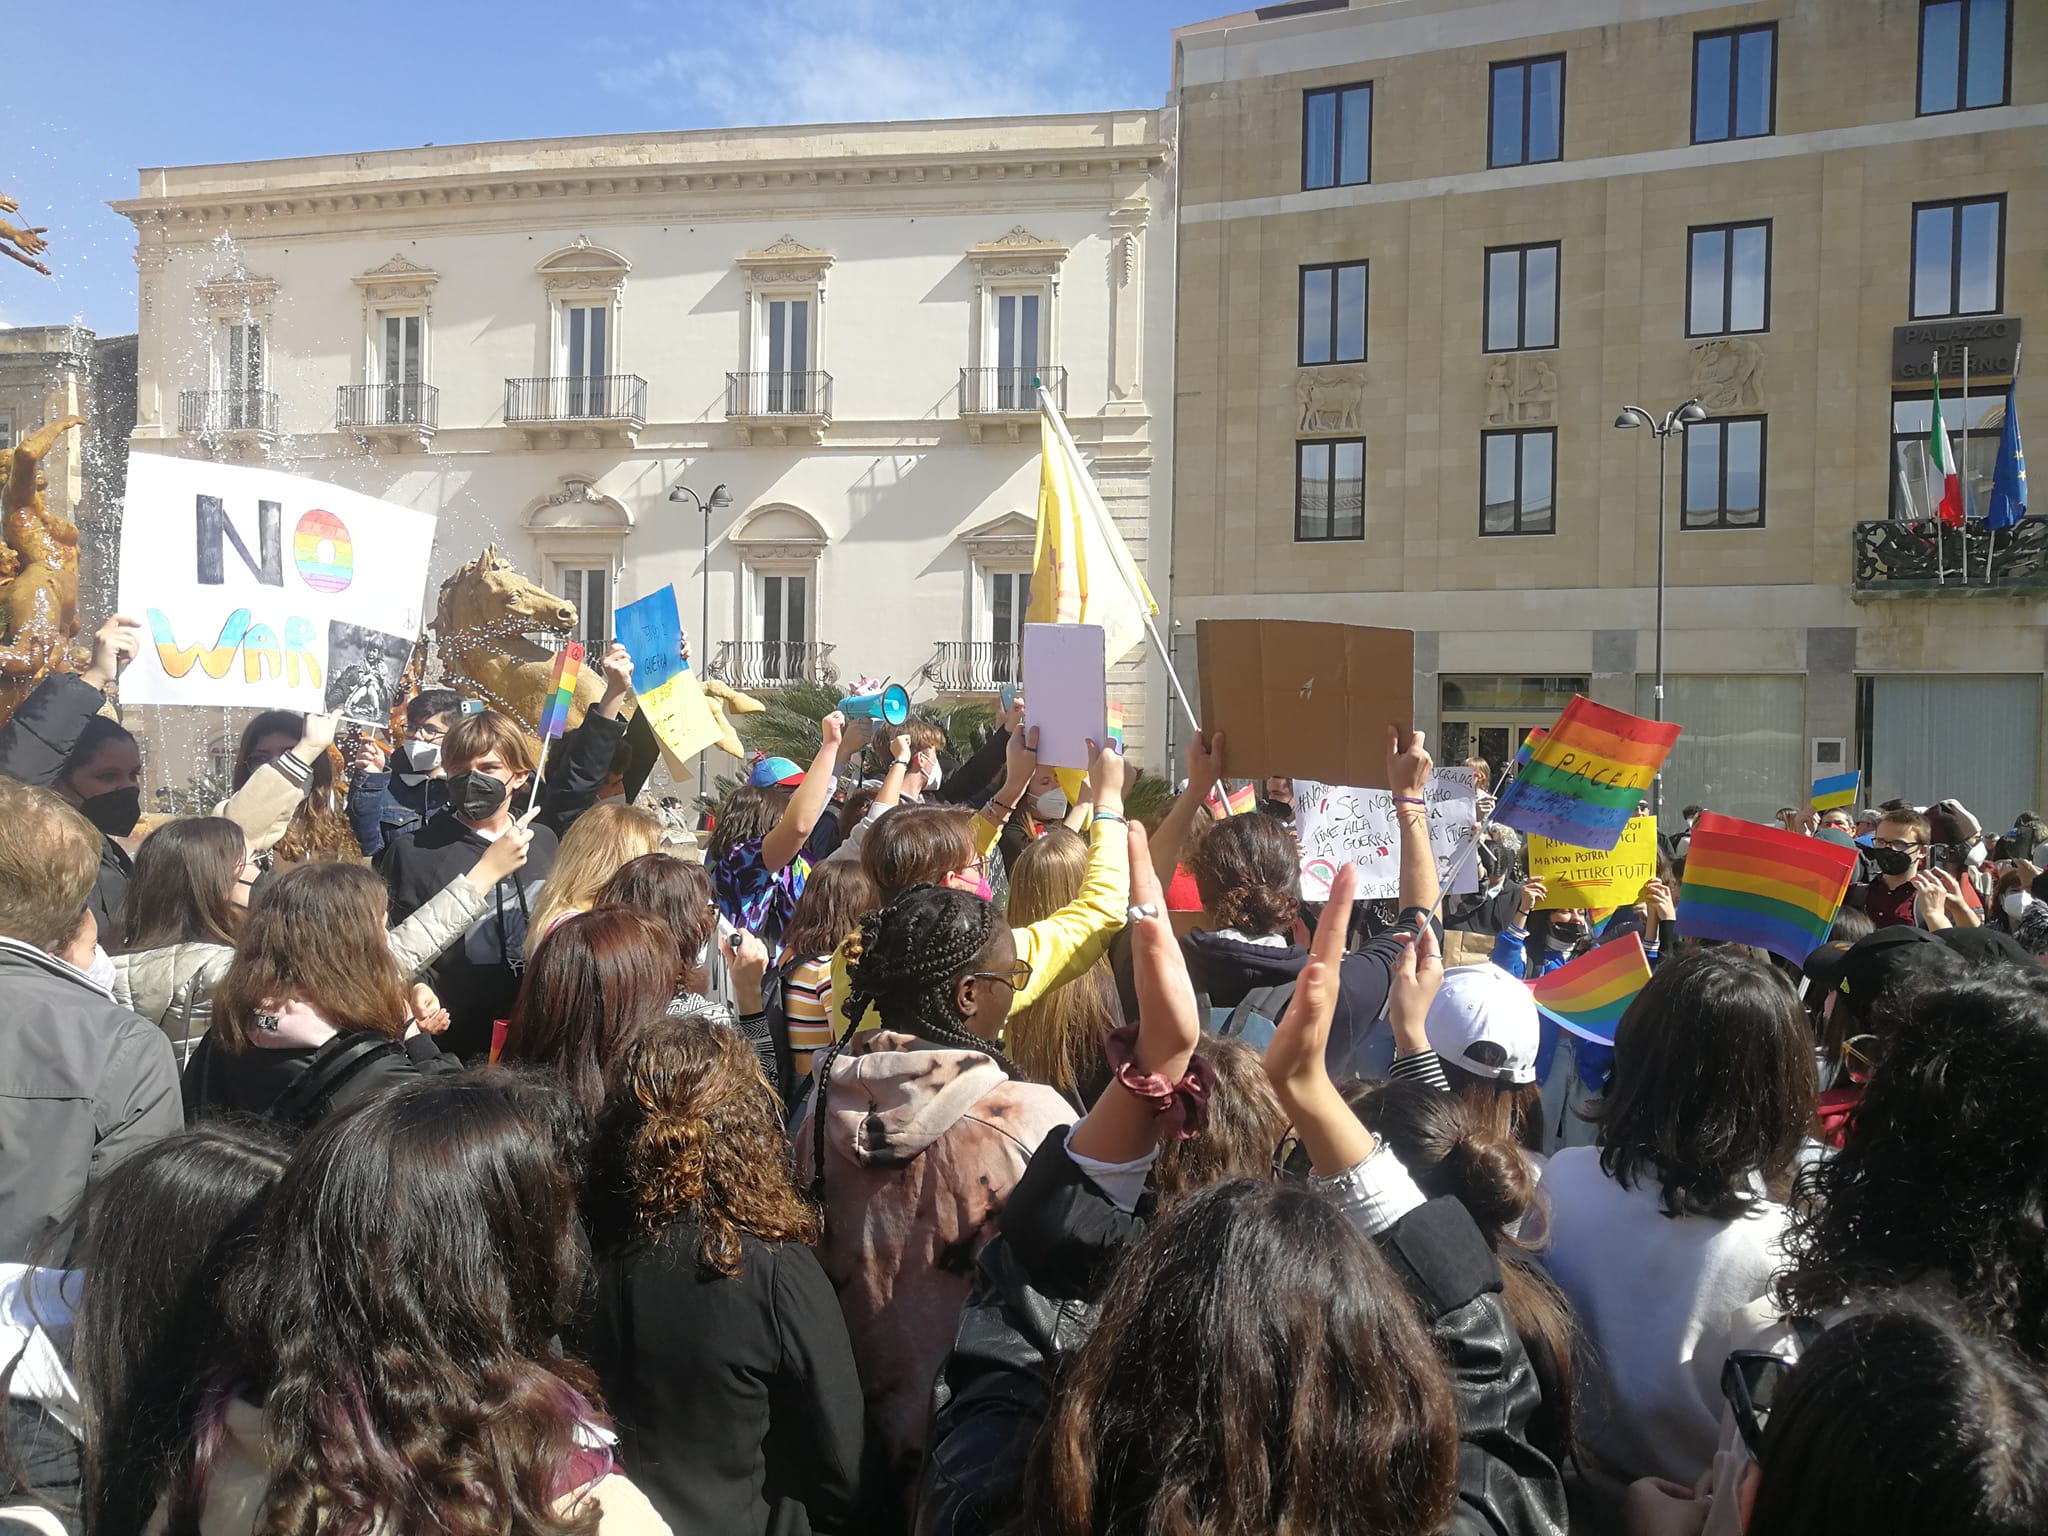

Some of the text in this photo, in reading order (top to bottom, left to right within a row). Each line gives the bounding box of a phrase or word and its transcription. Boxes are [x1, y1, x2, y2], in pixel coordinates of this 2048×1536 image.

[1904, 321, 2009, 344] PALAZZO
[196, 493, 353, 593] NO
[147, 607, 322, 689] WAR
[1312, 818, 1372, 845] FINE ALLA
[1316, 842, 1335, 858] LA
[1342, 831, 1394, 851] GUERRA
[1551, 855, 1571, 865] NON
[1554, 863, 1654, 882] ZITTIRCI TUTTI
